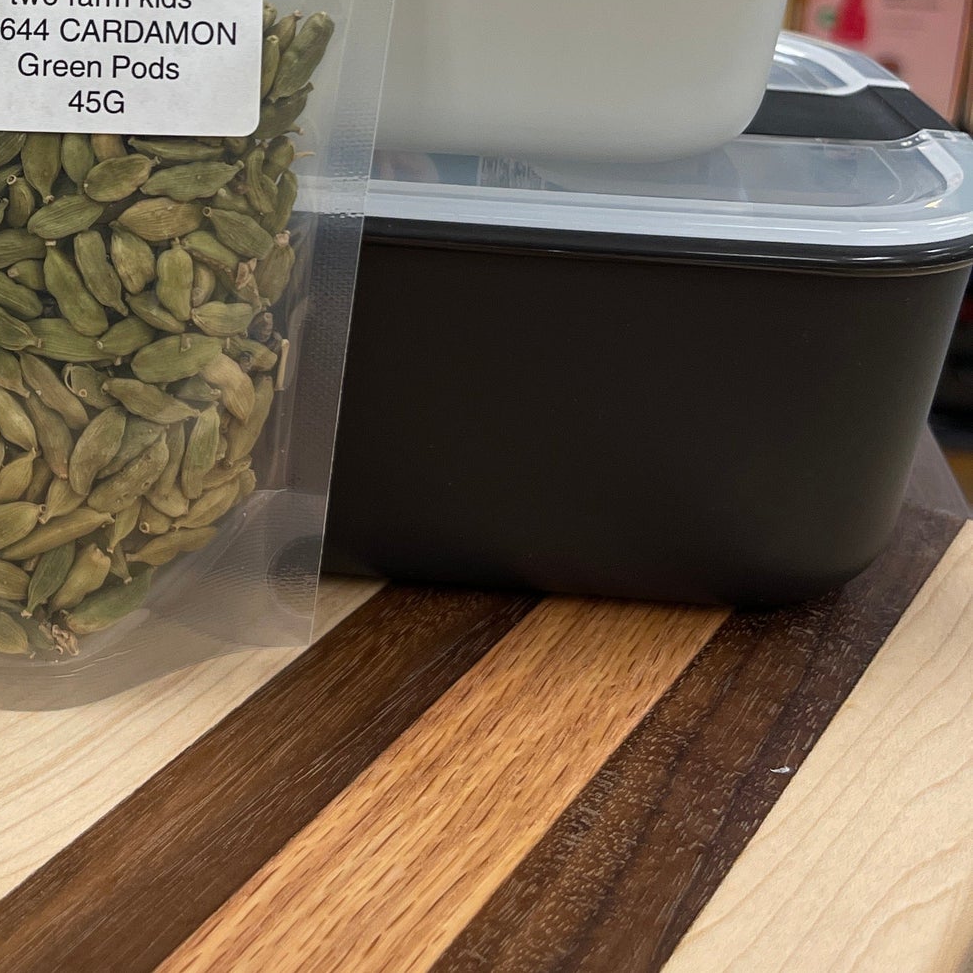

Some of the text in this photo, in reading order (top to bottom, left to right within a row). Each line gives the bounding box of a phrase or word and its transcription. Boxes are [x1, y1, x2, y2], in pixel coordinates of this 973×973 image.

[59, 17, 237, 46] CARDAMON
[17, 52, 180, 80] Green Pods
[68, 89, 125, 114] 45G
